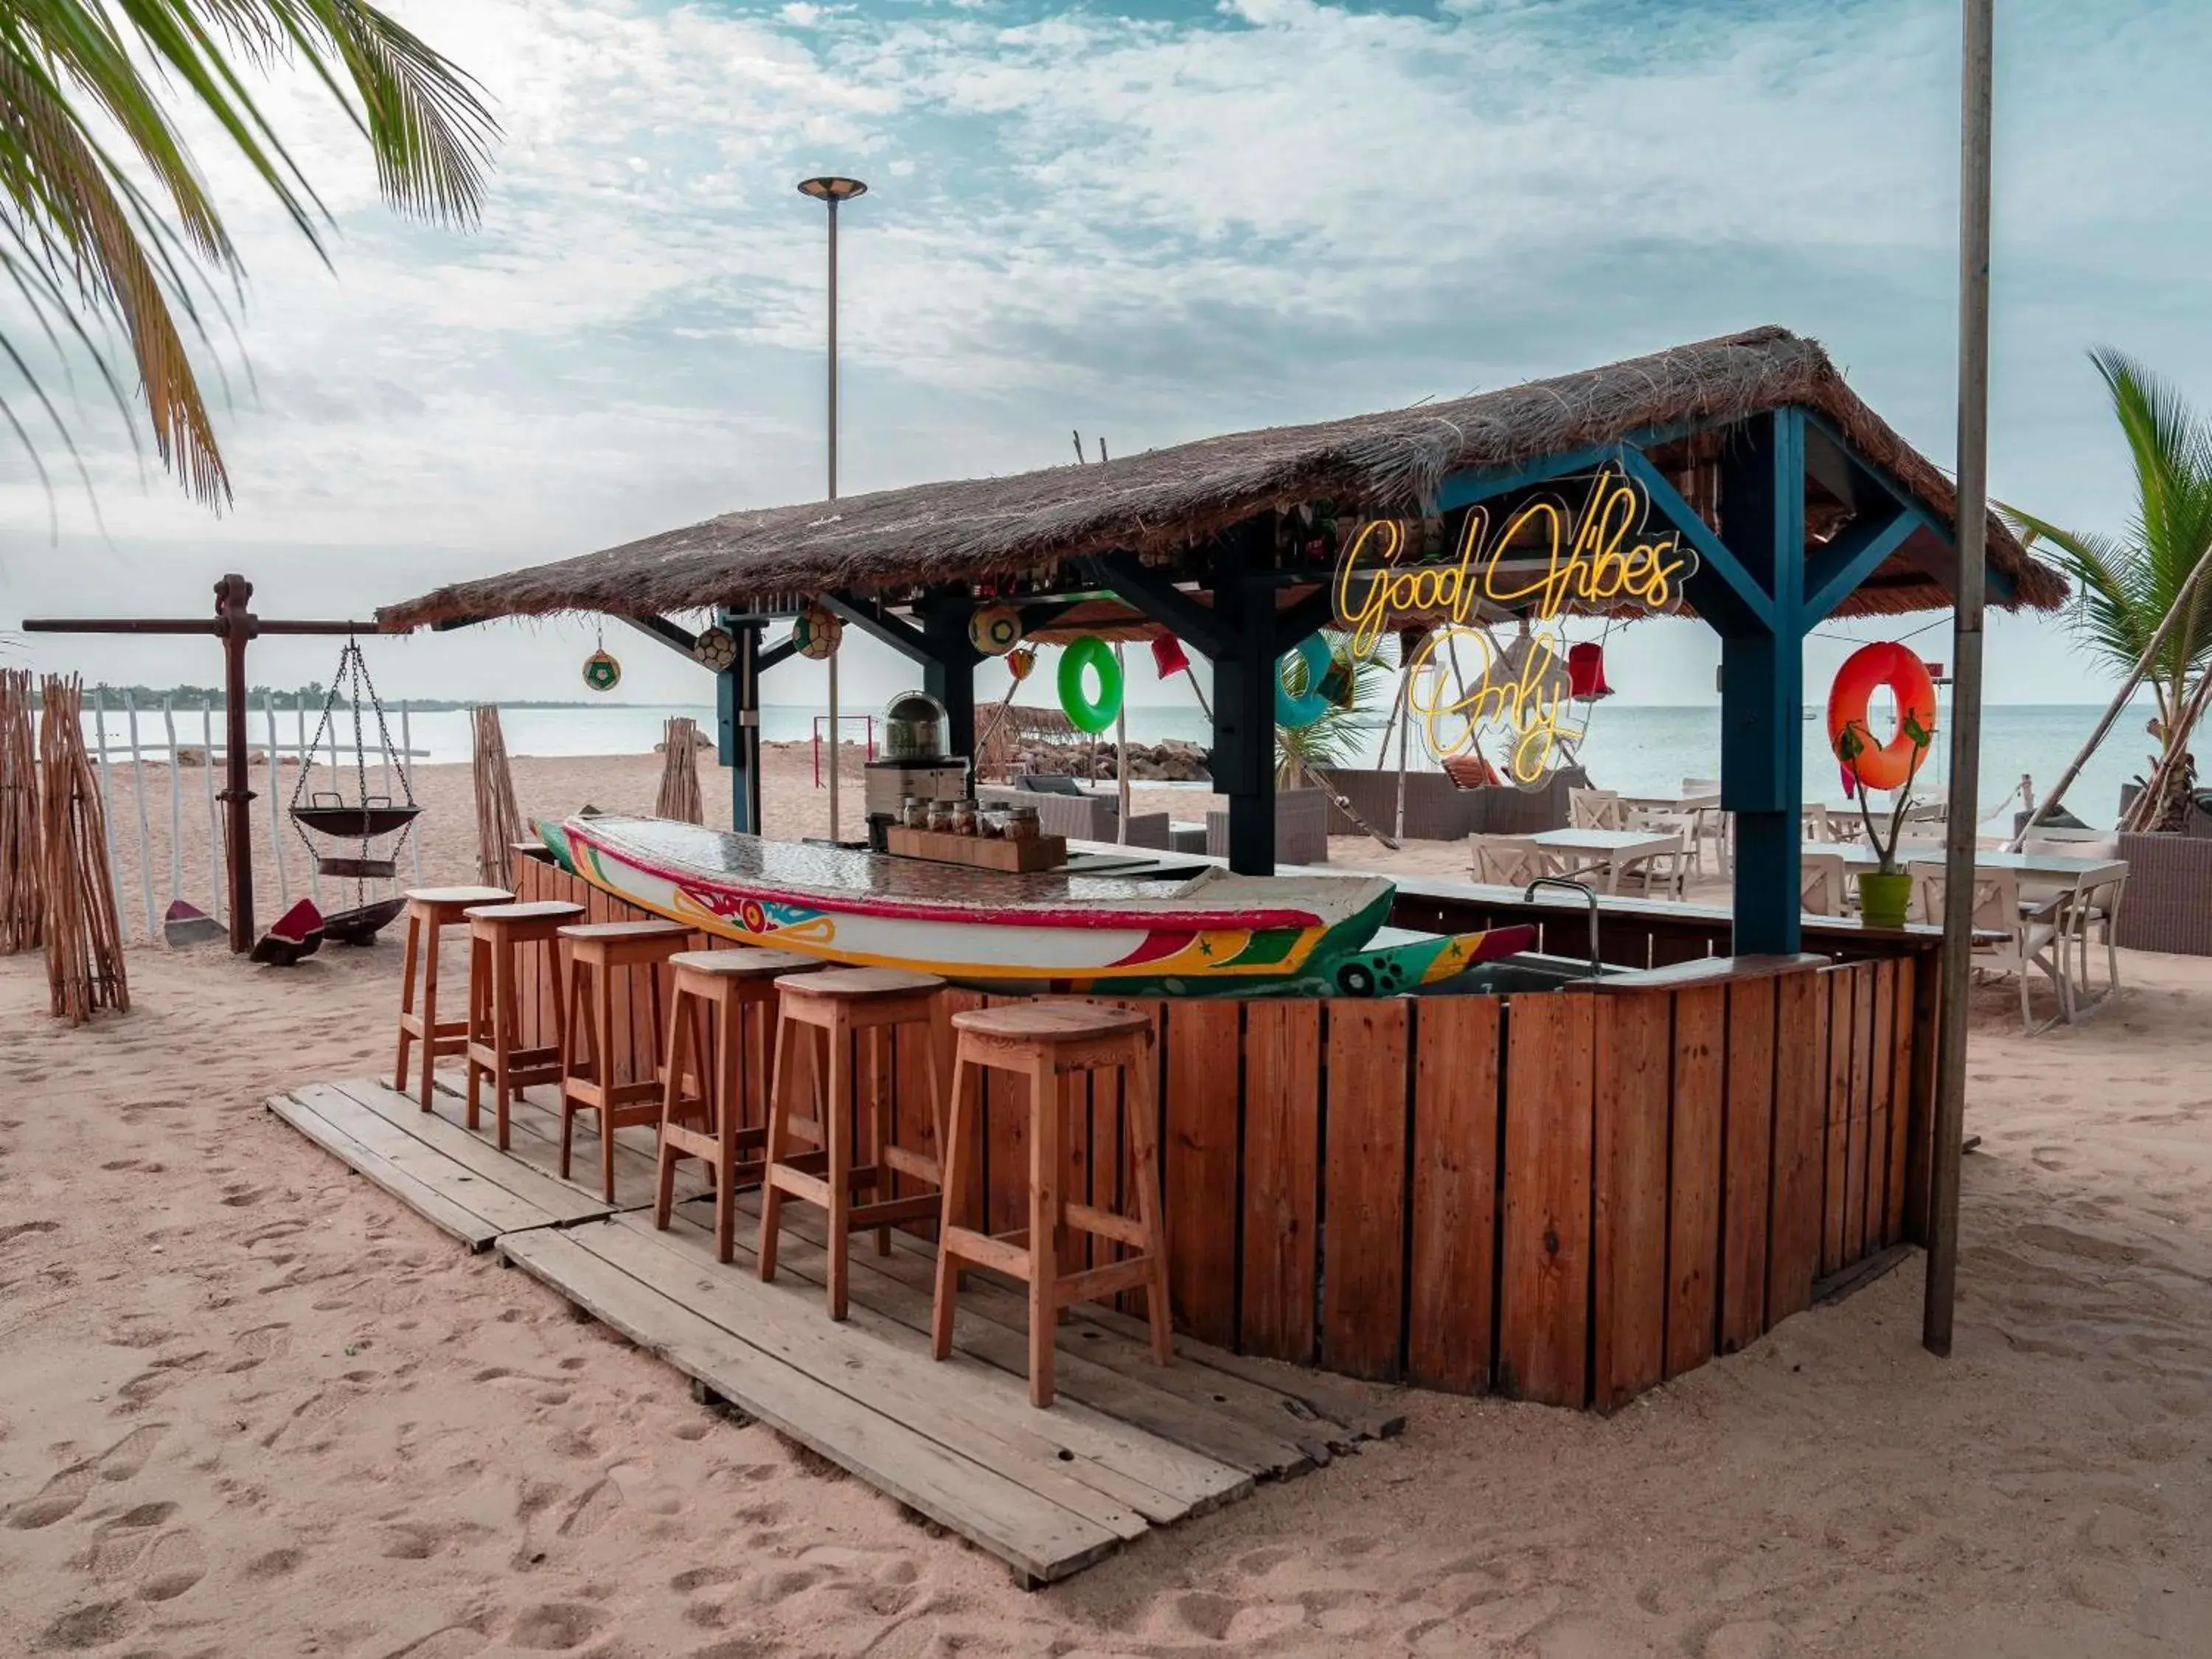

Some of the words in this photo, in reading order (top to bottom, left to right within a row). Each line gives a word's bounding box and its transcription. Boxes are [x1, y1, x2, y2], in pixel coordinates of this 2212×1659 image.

[1340, 517, 1479, 656] Good
[1485, 470, 1684, 621] Vibes
[1408, 627, 1583, 783] Only
